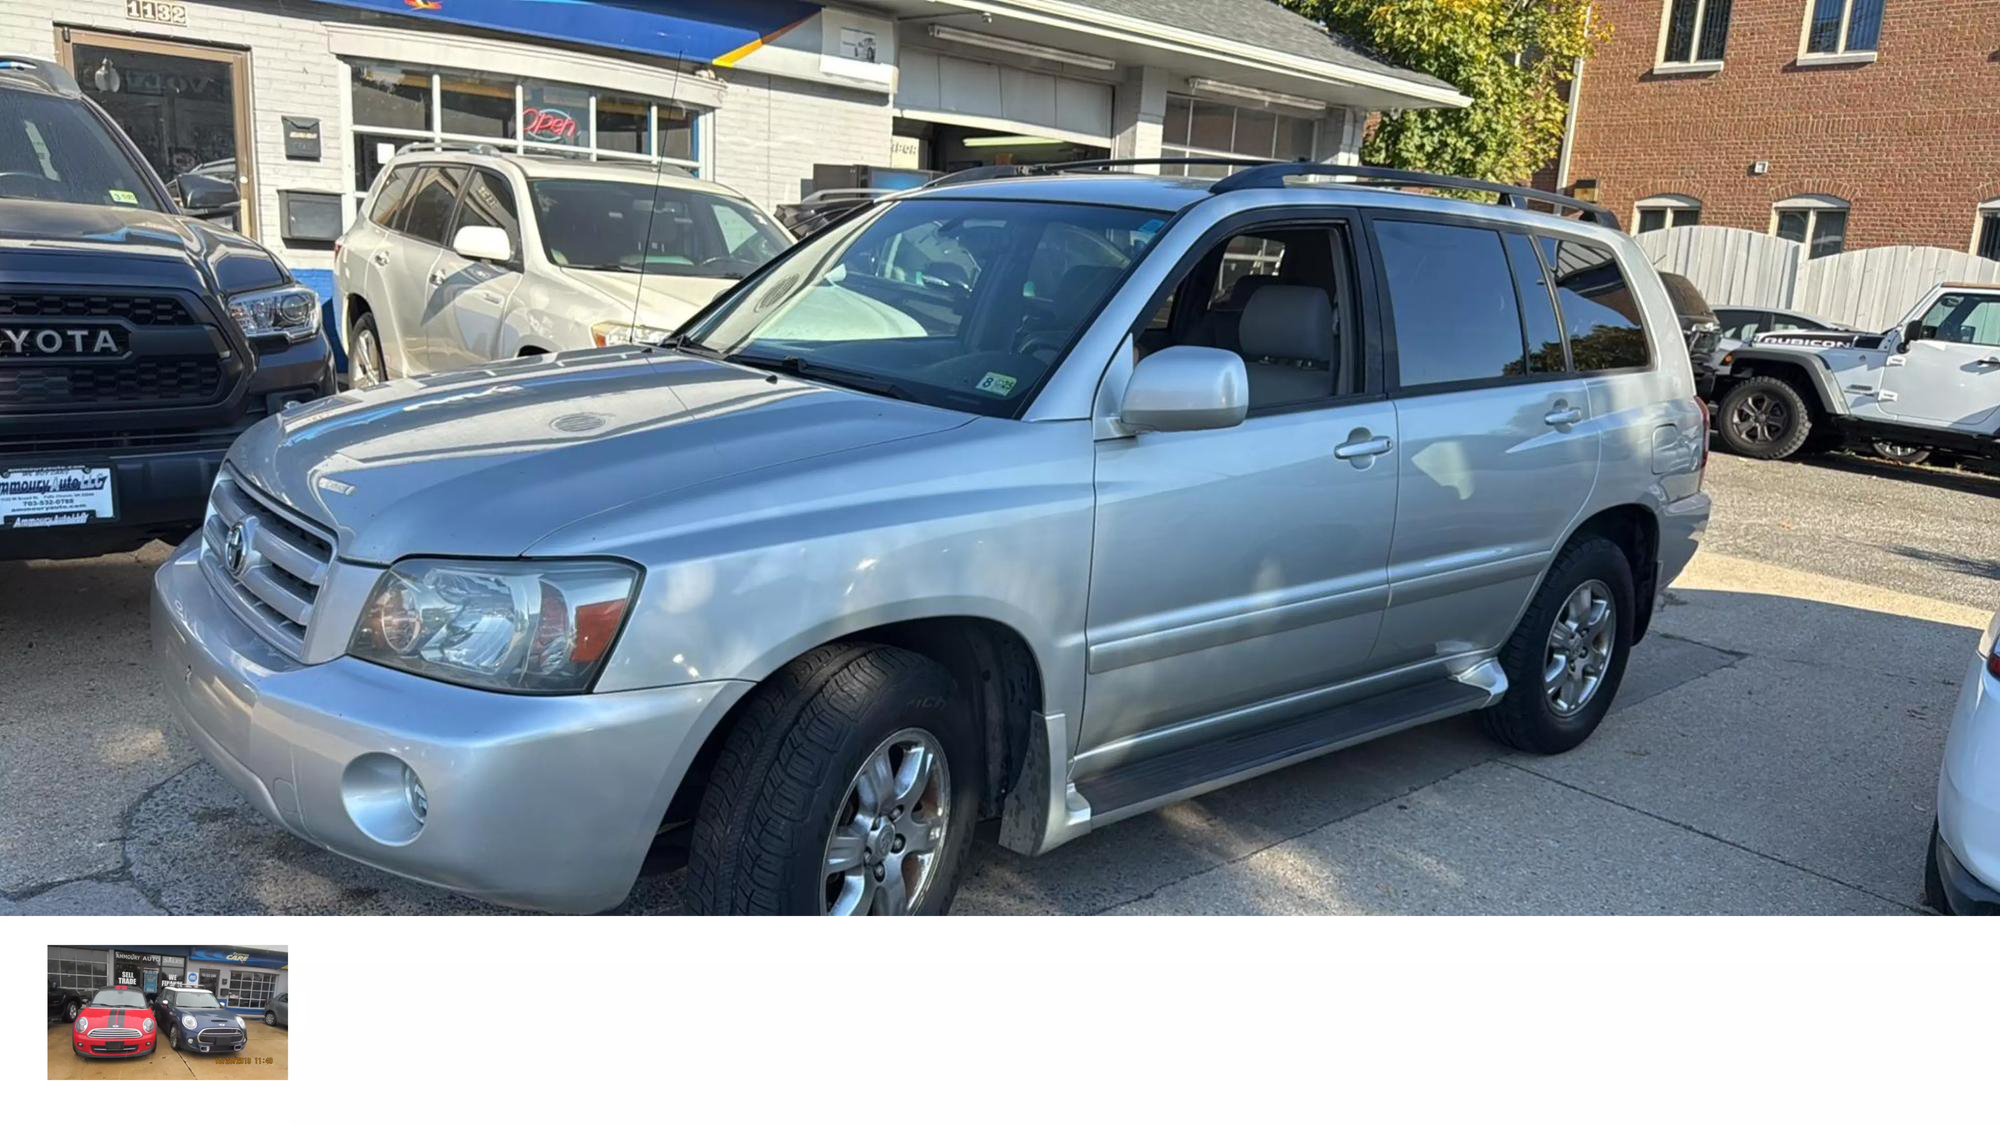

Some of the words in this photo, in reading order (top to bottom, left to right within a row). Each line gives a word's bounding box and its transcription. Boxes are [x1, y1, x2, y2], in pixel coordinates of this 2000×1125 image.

[126, 0, 187, 25] 1132
[521, 108, 576, 136] Open
[4, 329, 119, 353] YOTA
[1764, 337, 1851, 348] RUBICON
[982, 377, 994, 388] 8
